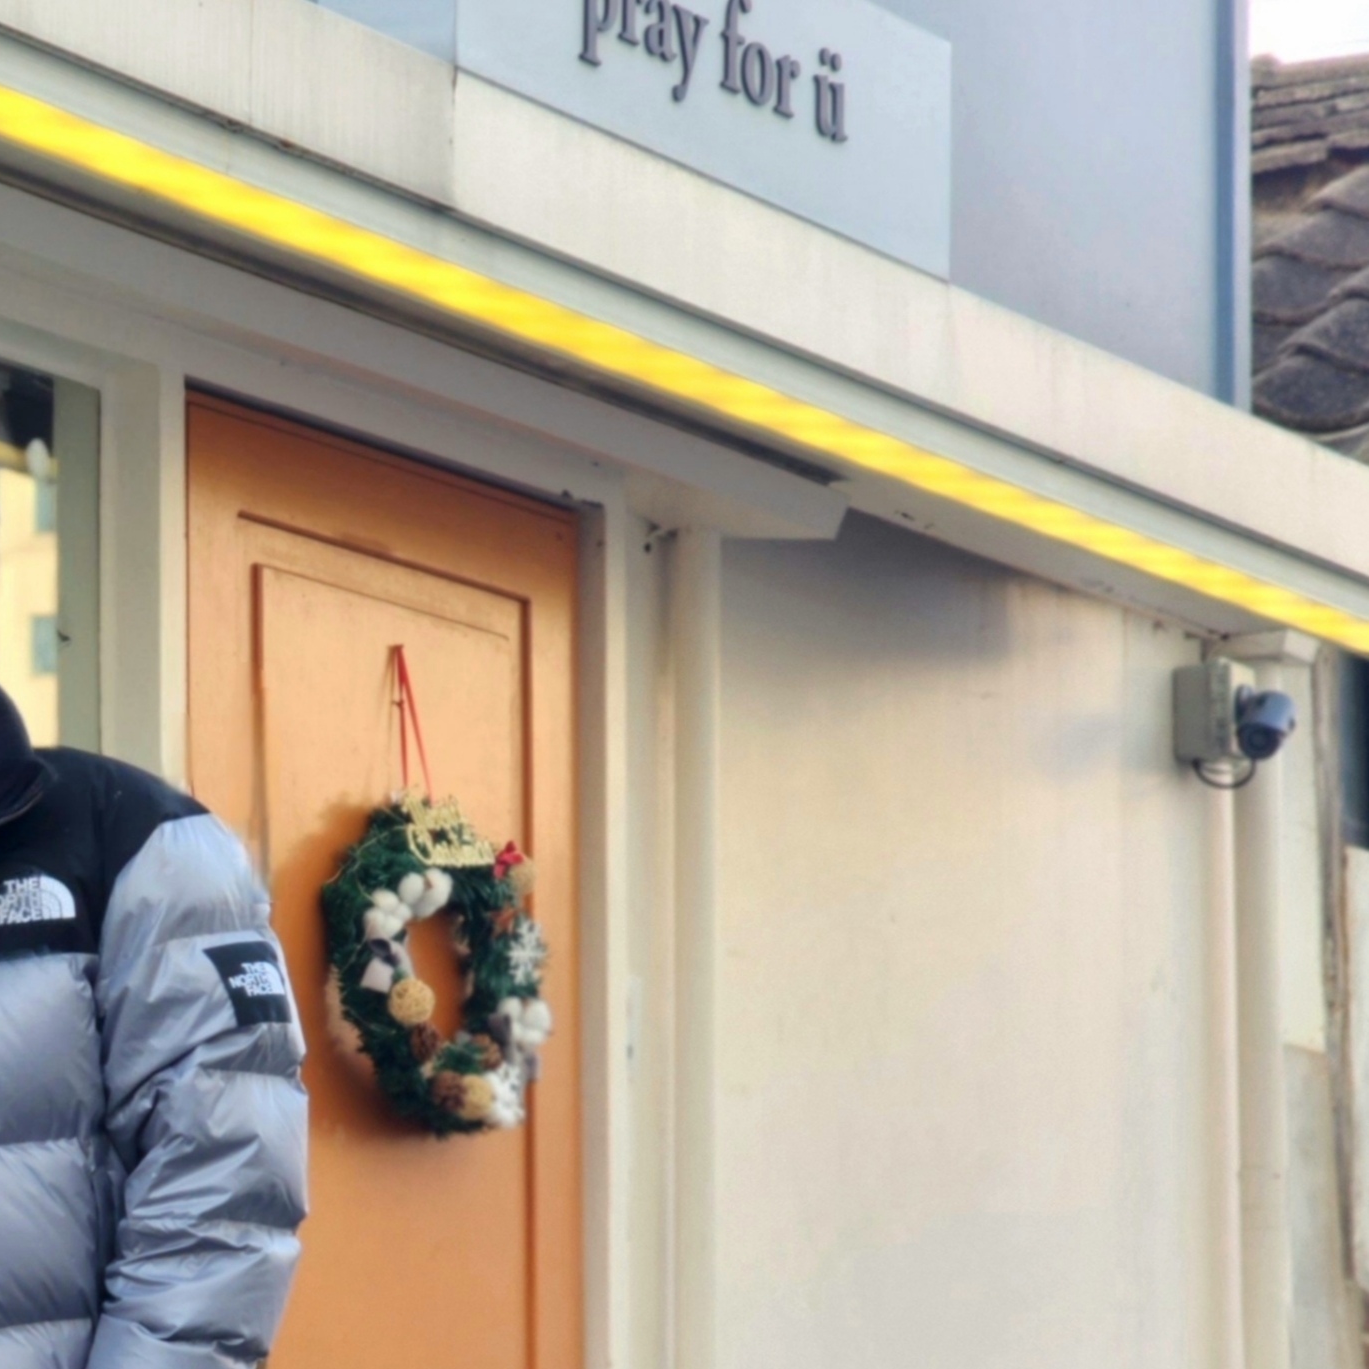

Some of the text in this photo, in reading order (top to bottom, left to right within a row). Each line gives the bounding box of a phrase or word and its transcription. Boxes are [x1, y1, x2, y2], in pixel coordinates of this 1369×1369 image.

[578, 0, 848, 143] pray for ü
